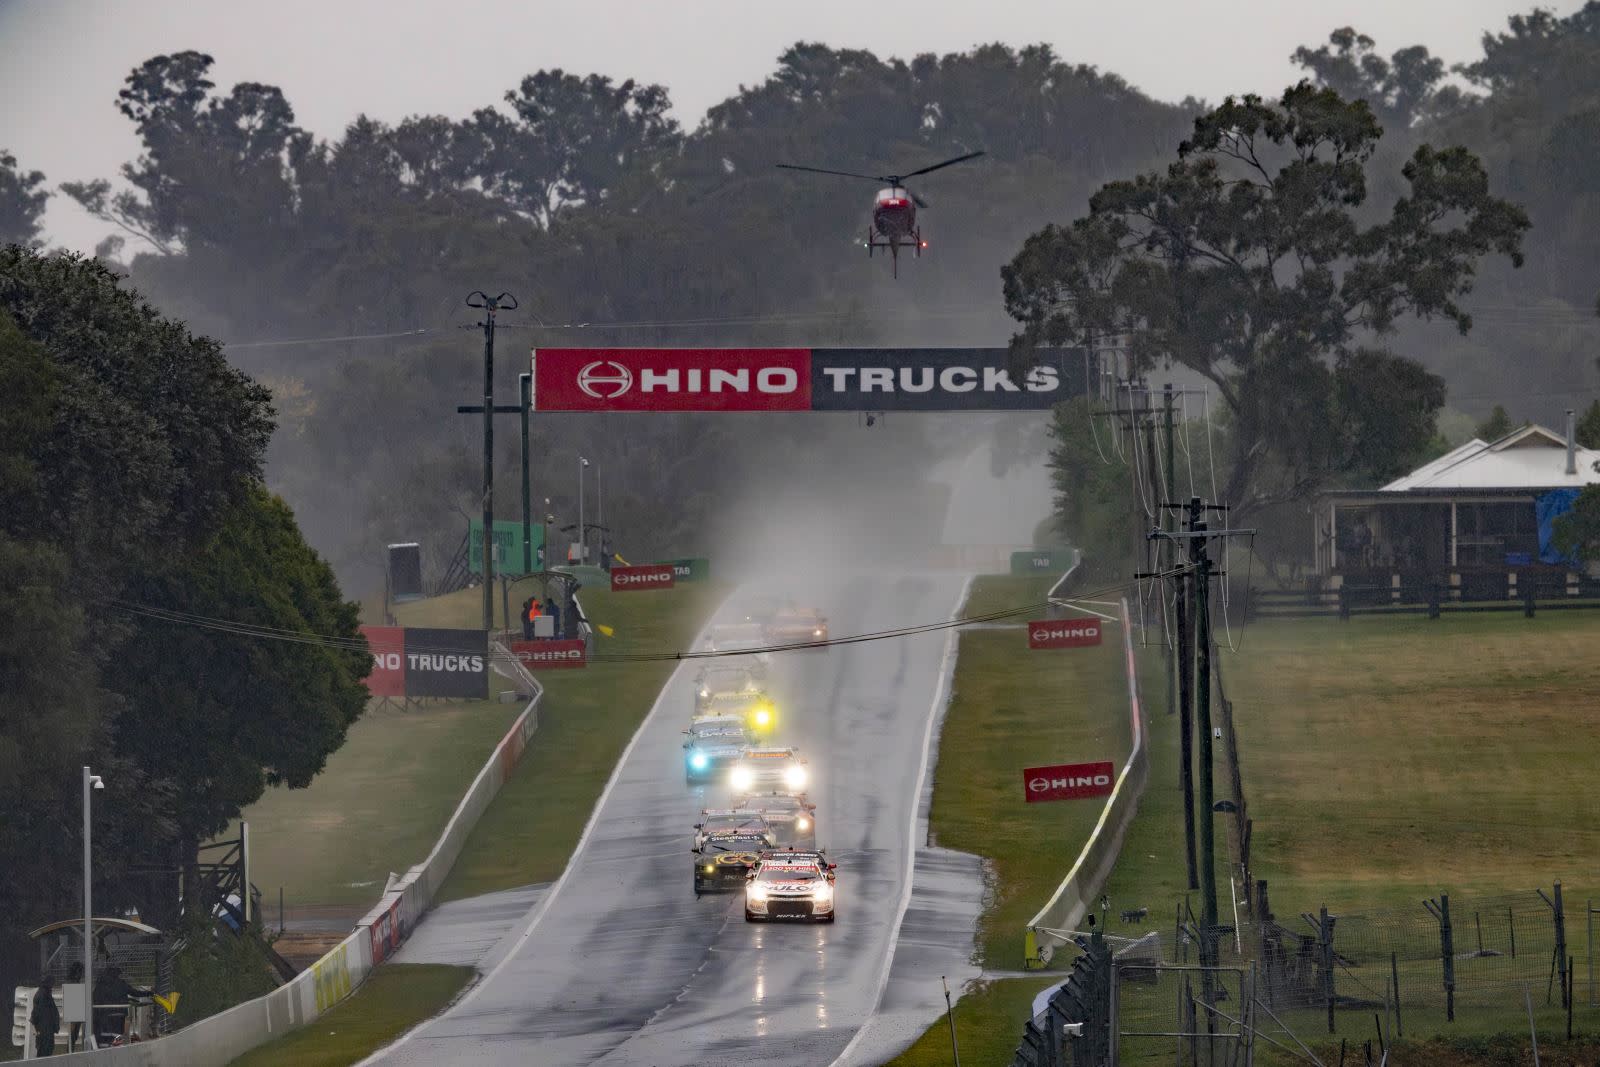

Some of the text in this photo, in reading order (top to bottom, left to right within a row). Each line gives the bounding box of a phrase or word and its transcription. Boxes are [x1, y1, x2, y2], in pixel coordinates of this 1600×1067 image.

[640, 366, 1060, 393] HINO TRUCKS
[1032, 557, 1050, 567] TAB
[673, 566, 690, 576] TAB
[629, 572, 671, 584] HINO
[1050, 626, 1098, 639] HINO
[531, 648, 581, 661] HINO
[373, 653, 484, 673] NO TRUCKS
[1051, 774, 1110, 790] HINO
